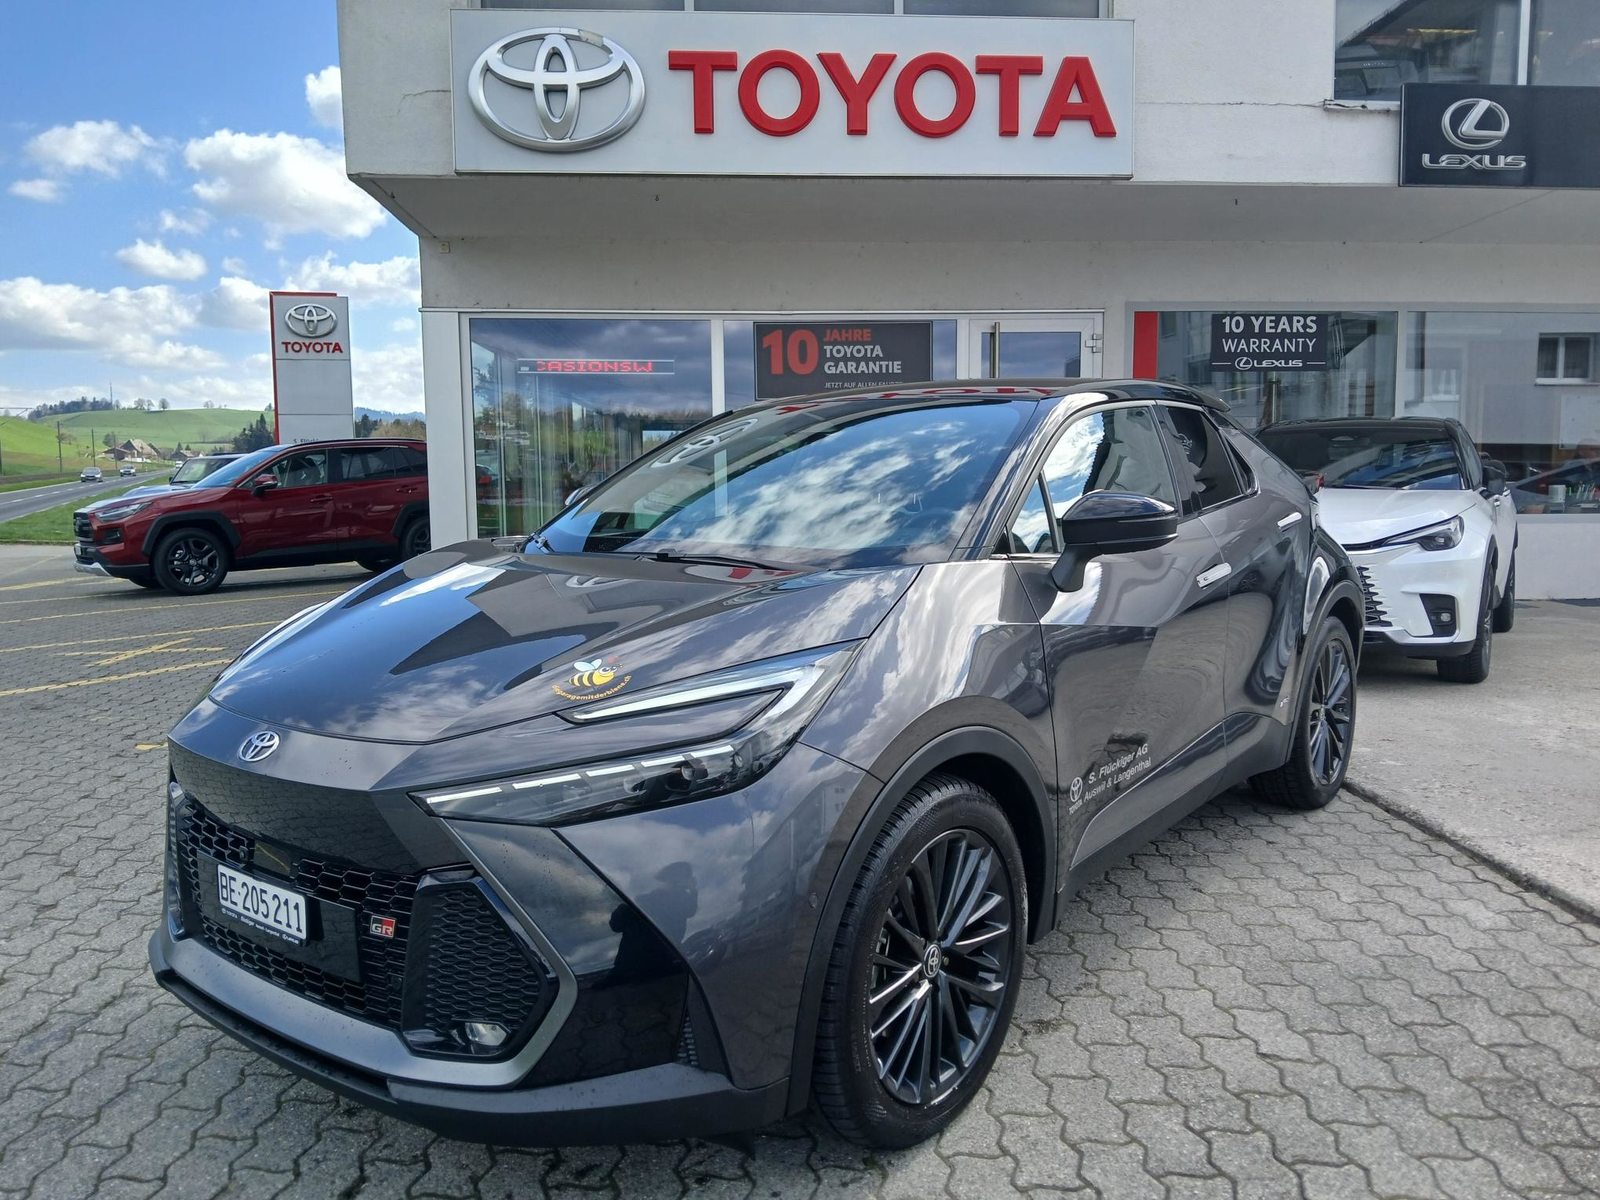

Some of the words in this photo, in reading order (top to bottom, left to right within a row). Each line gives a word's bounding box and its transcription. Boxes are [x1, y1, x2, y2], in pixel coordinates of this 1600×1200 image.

[668, 49, 1117, 138] TOYOTA
[1422, 153, 1527, 170] LEXUS
[1222, 316, 1245, 333] 10
[1250, 316, 1317, 333] YEARS
[823, 328, 872, 341] JAHRE
[281, 341, 344, 353] TOYOTA
[762, 329, 819, 375] 10
[823, 345, 883, 358] TOYOTA
[1222, 338, 1316, 353] WARRANTY
[823, 361, 902, 374] GARANTIE
[1254, 359, 1303, 367] LEXUS
[1088, 771, 1097, 784] S.
[1135, 743, 1148, 758] AG
[1113, 757, 1152, 784] Langenthal
[372, 923, 393, 937] GR
